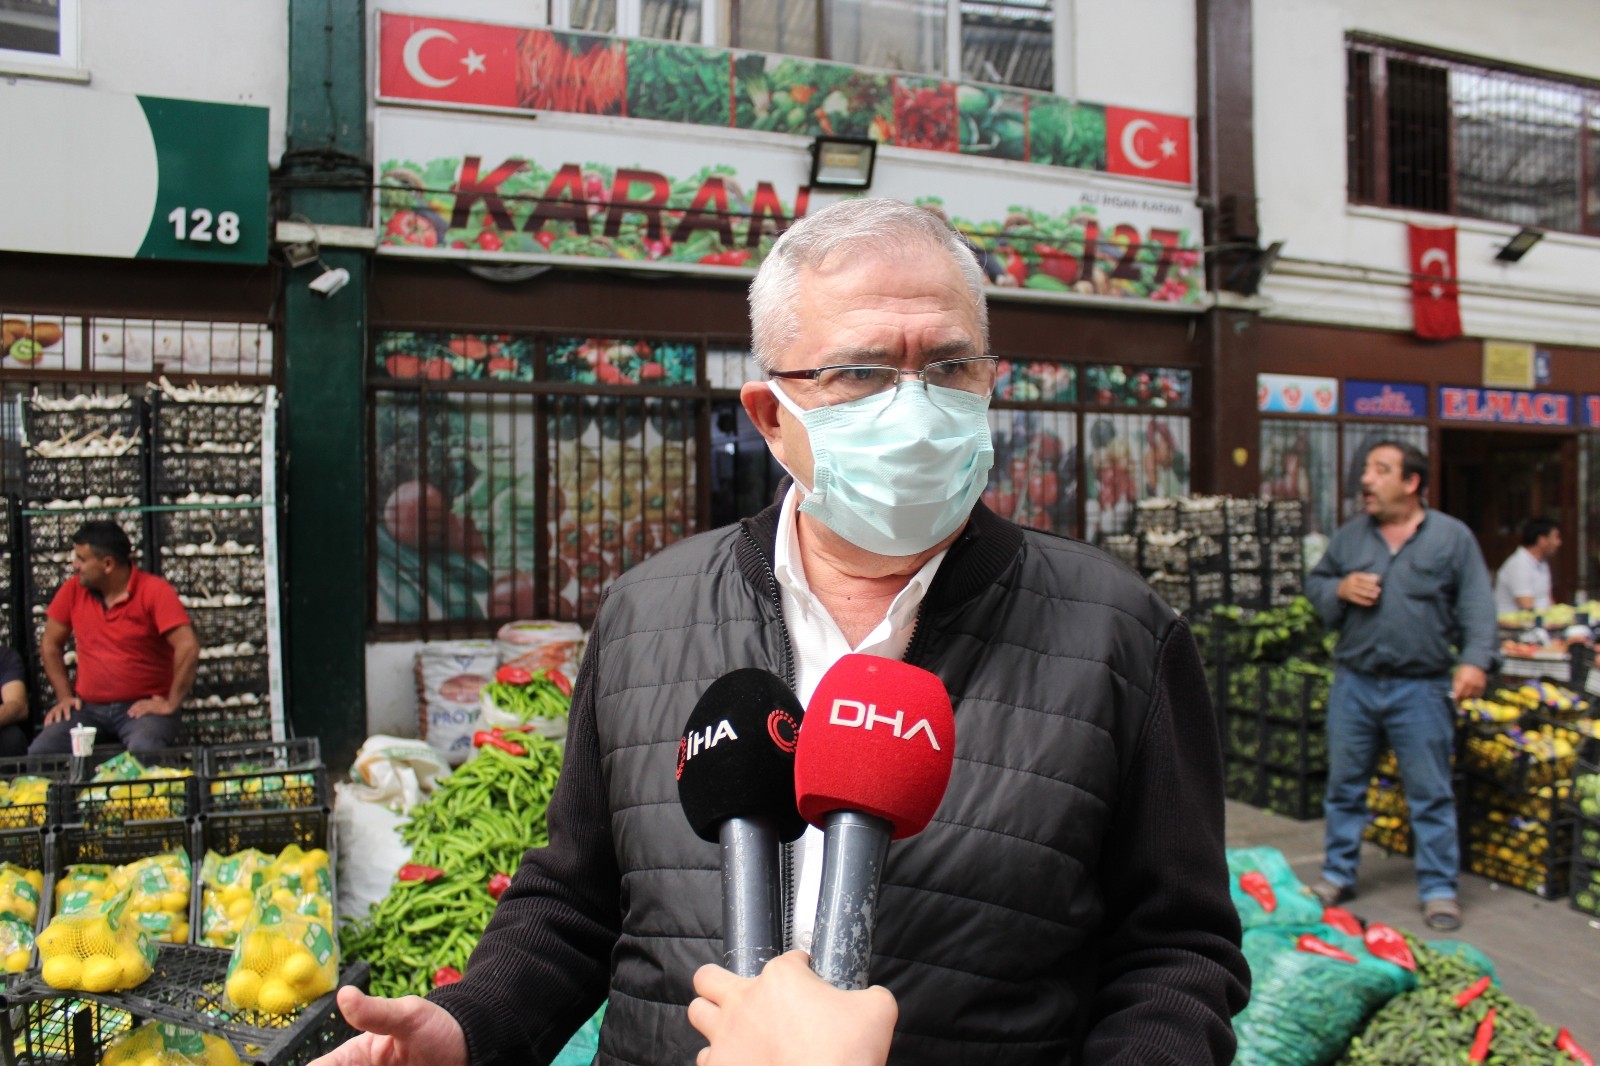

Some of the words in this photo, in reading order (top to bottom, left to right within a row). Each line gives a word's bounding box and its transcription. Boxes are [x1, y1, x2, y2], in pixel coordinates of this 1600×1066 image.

[168, 206, 240, 245] 128
[449, 154, 812, 248] KARAN
[1081, 219, 1181, 284] 127
[1440, 387, 1570, 425] ELMACI
[829, 699, 941, 751] DHA
